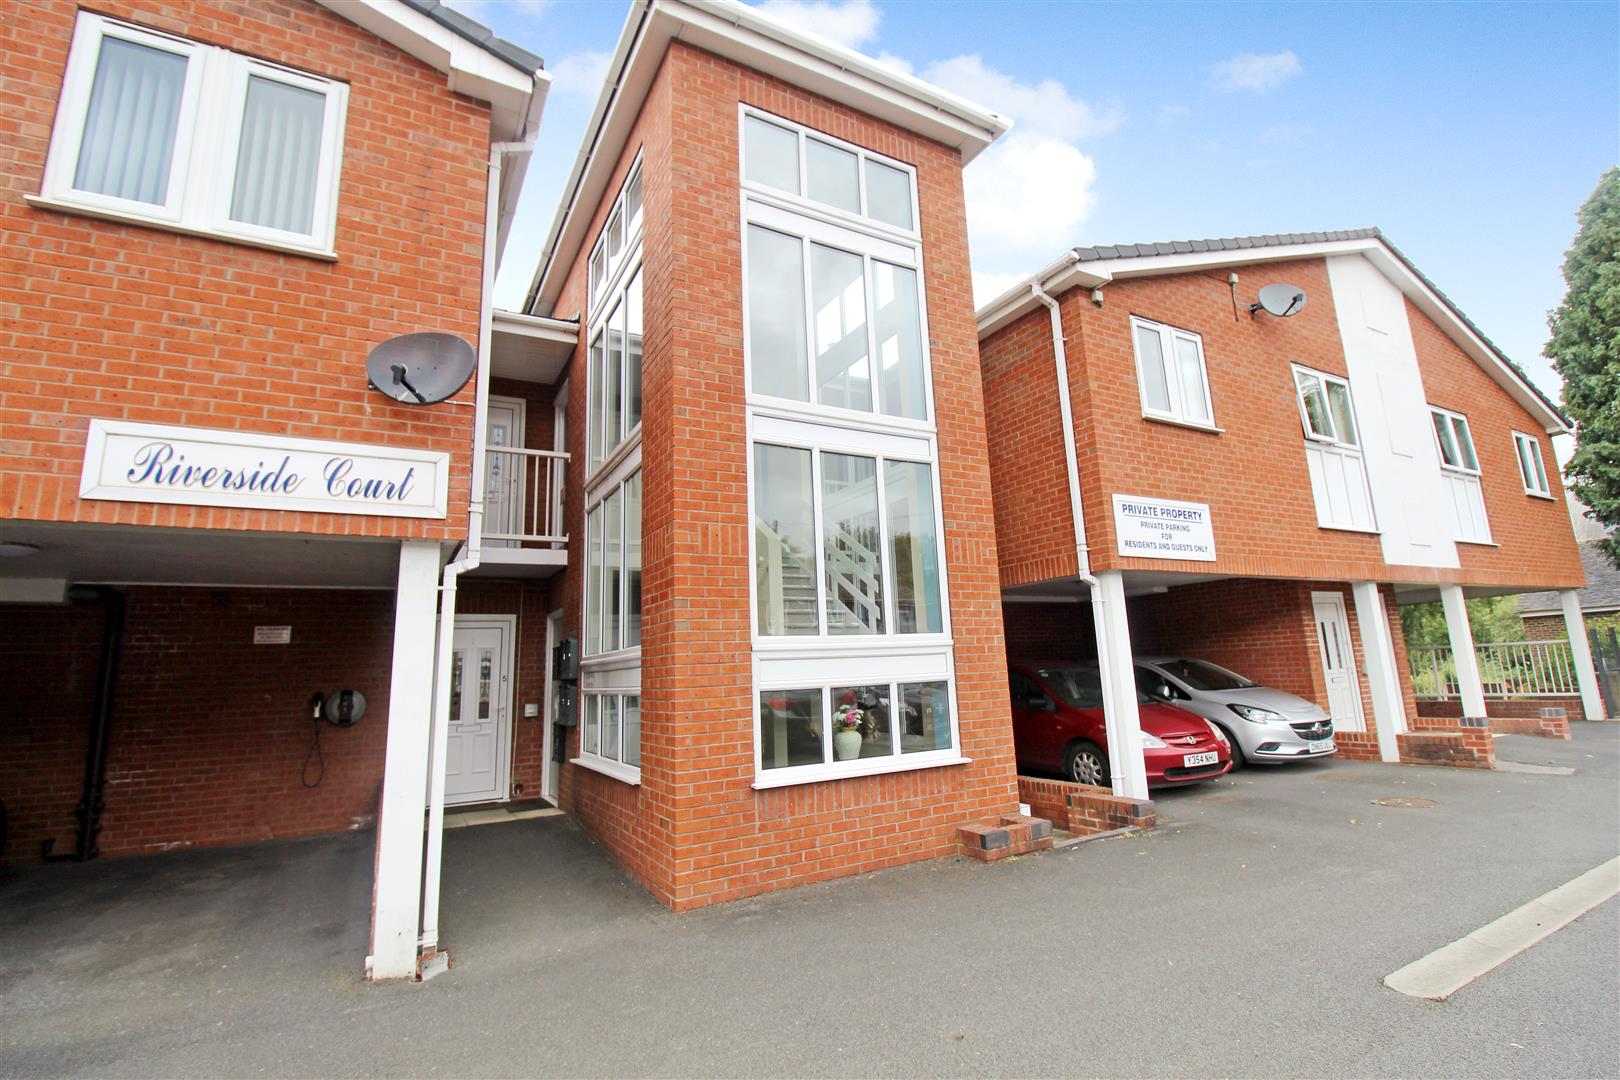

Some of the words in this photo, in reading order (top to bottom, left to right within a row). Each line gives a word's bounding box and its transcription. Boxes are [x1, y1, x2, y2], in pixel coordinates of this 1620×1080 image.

[127, 441, 306, 494] Riverside
[323, 457, 415, 501] Court
[1122, 504, 1158, 516] PRIVATE
[1160, 508, 1202, 521] PROPERTY
[1140, 521, 1164, 530] PRIVATE
[1165, 524, 1190, 532] PARKING
[1161, 533, 1173, 541] FOR
[1125, 540, 1157, 549] RESIDENTS
[1158, 543, 1171, 551] AND
[1171, 544, 1193, 552] GUESTS
[1194, 545, 1208, 553] ONLY
[1187, 755, 1204, 765] Y354
